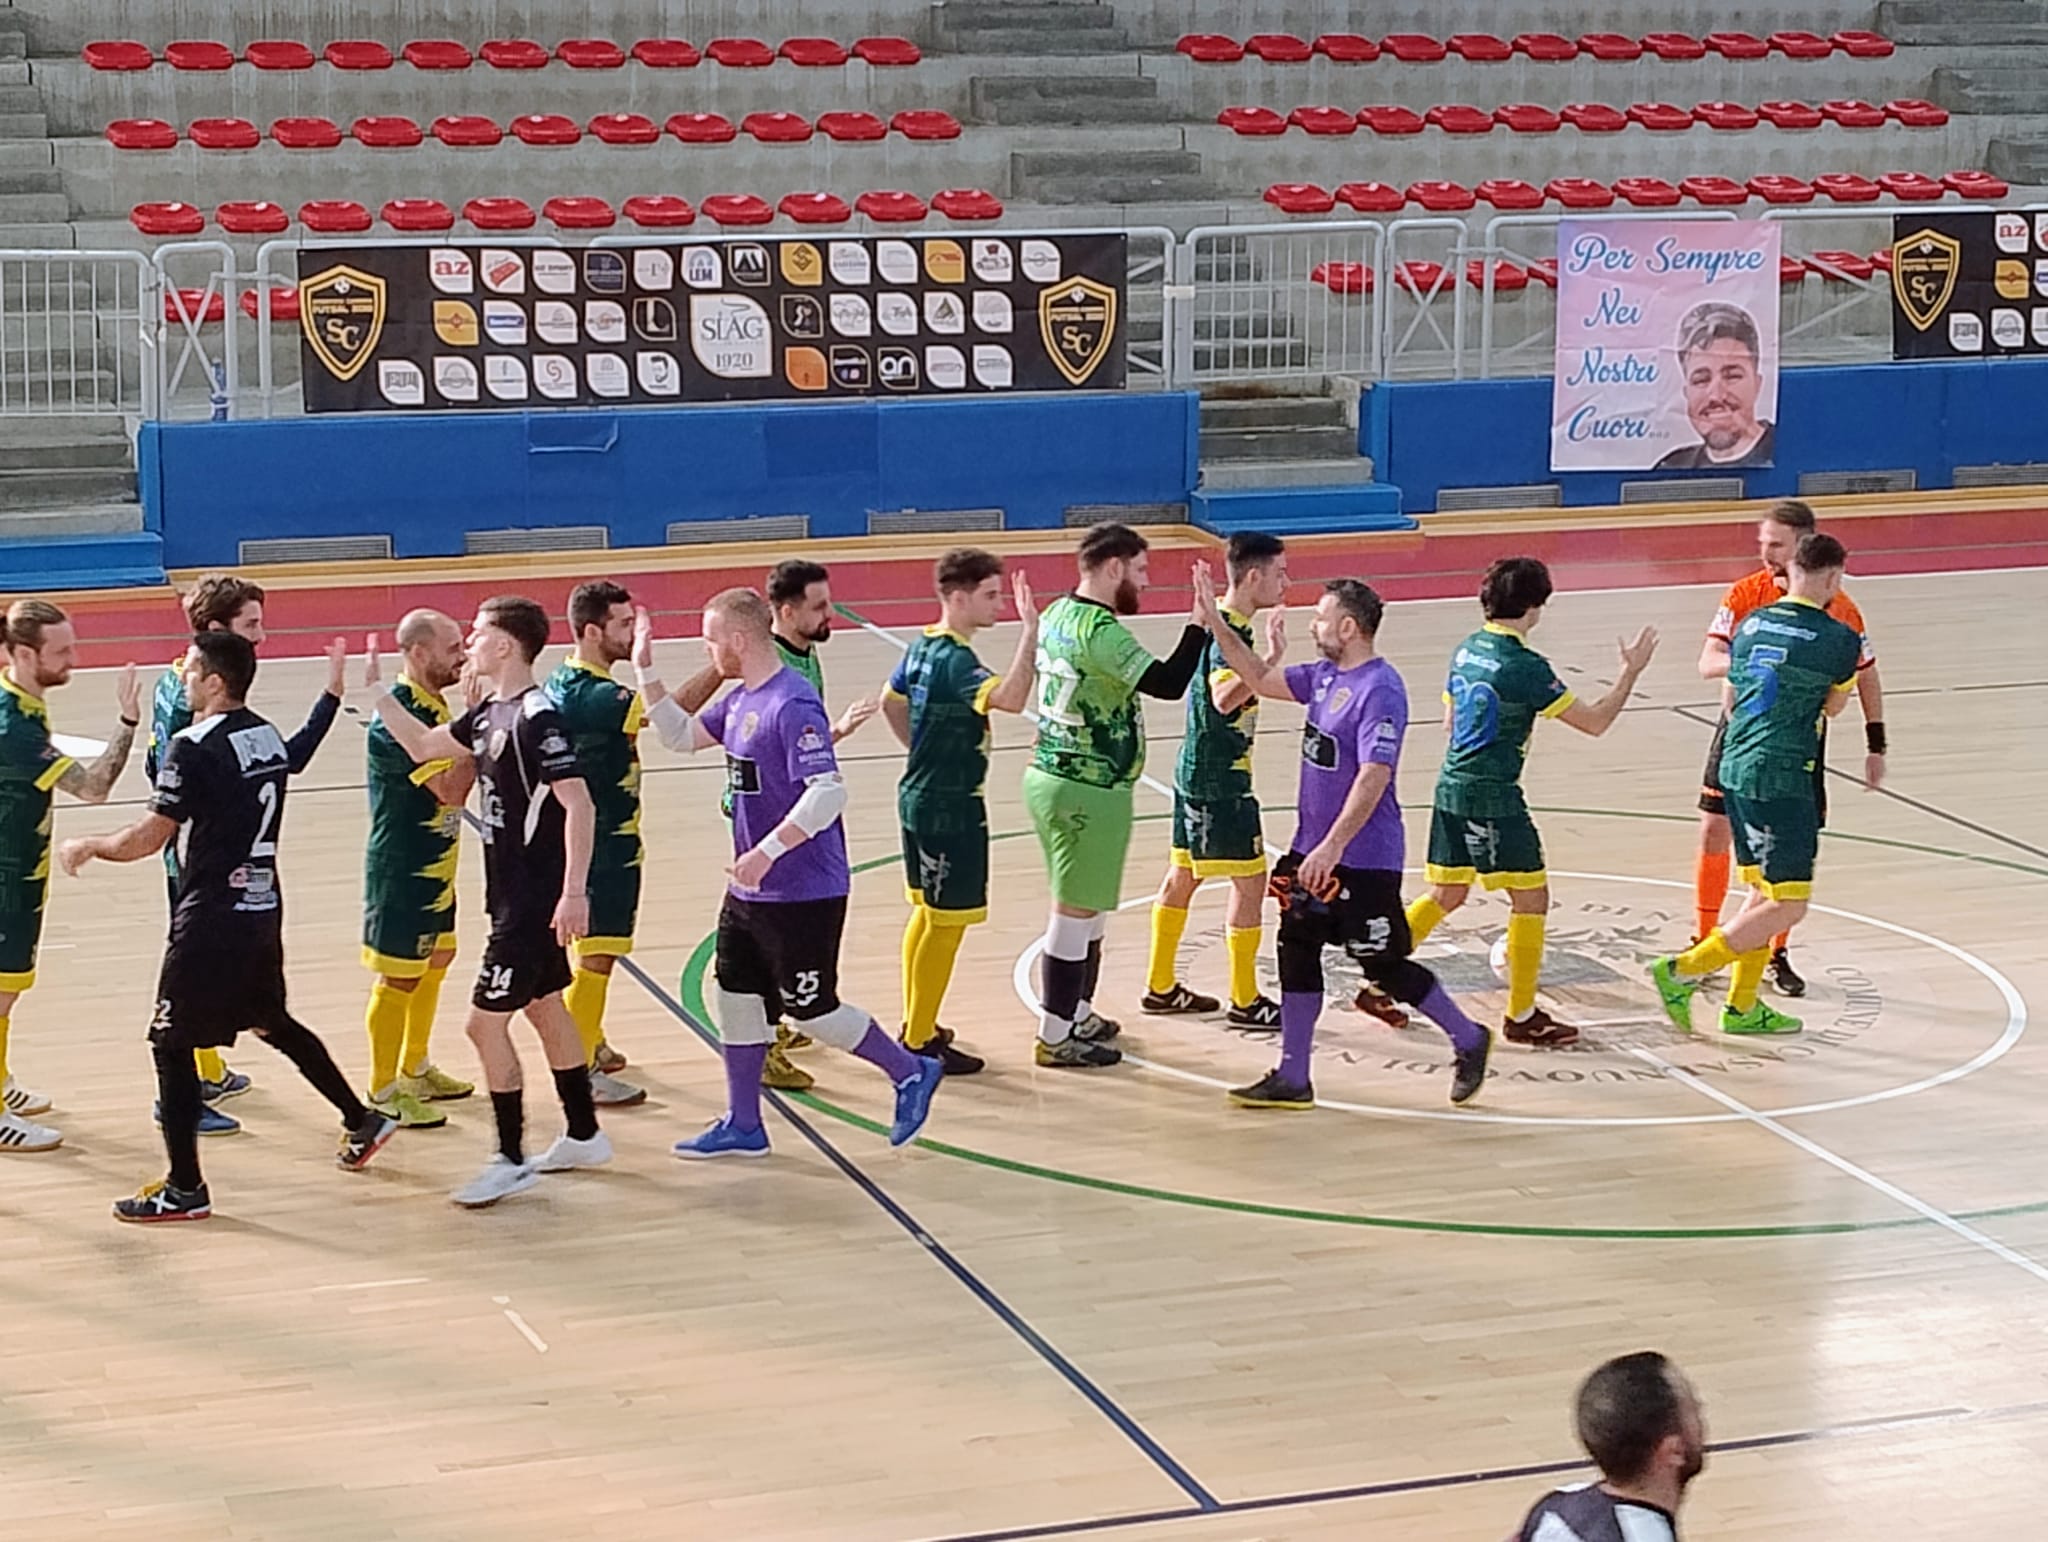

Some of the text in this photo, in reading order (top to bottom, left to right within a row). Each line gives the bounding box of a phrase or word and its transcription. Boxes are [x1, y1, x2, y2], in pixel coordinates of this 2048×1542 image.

[1568, 235, 1765, 284] Per Sempre
[1583, 288, 1643, 328] Nei
[326, 318, 360, 350] SC
[1061, 325, 1093, 357] SC
[715, 353, 753, 369] 1920
[1566, 347, 1659, 386] Nostri
[1742, 644, 1788, 716] 5
[250, 781, 277, 858] 2
[490, 964, 514, 990] 14
[796, 970, 819, 994] 25
